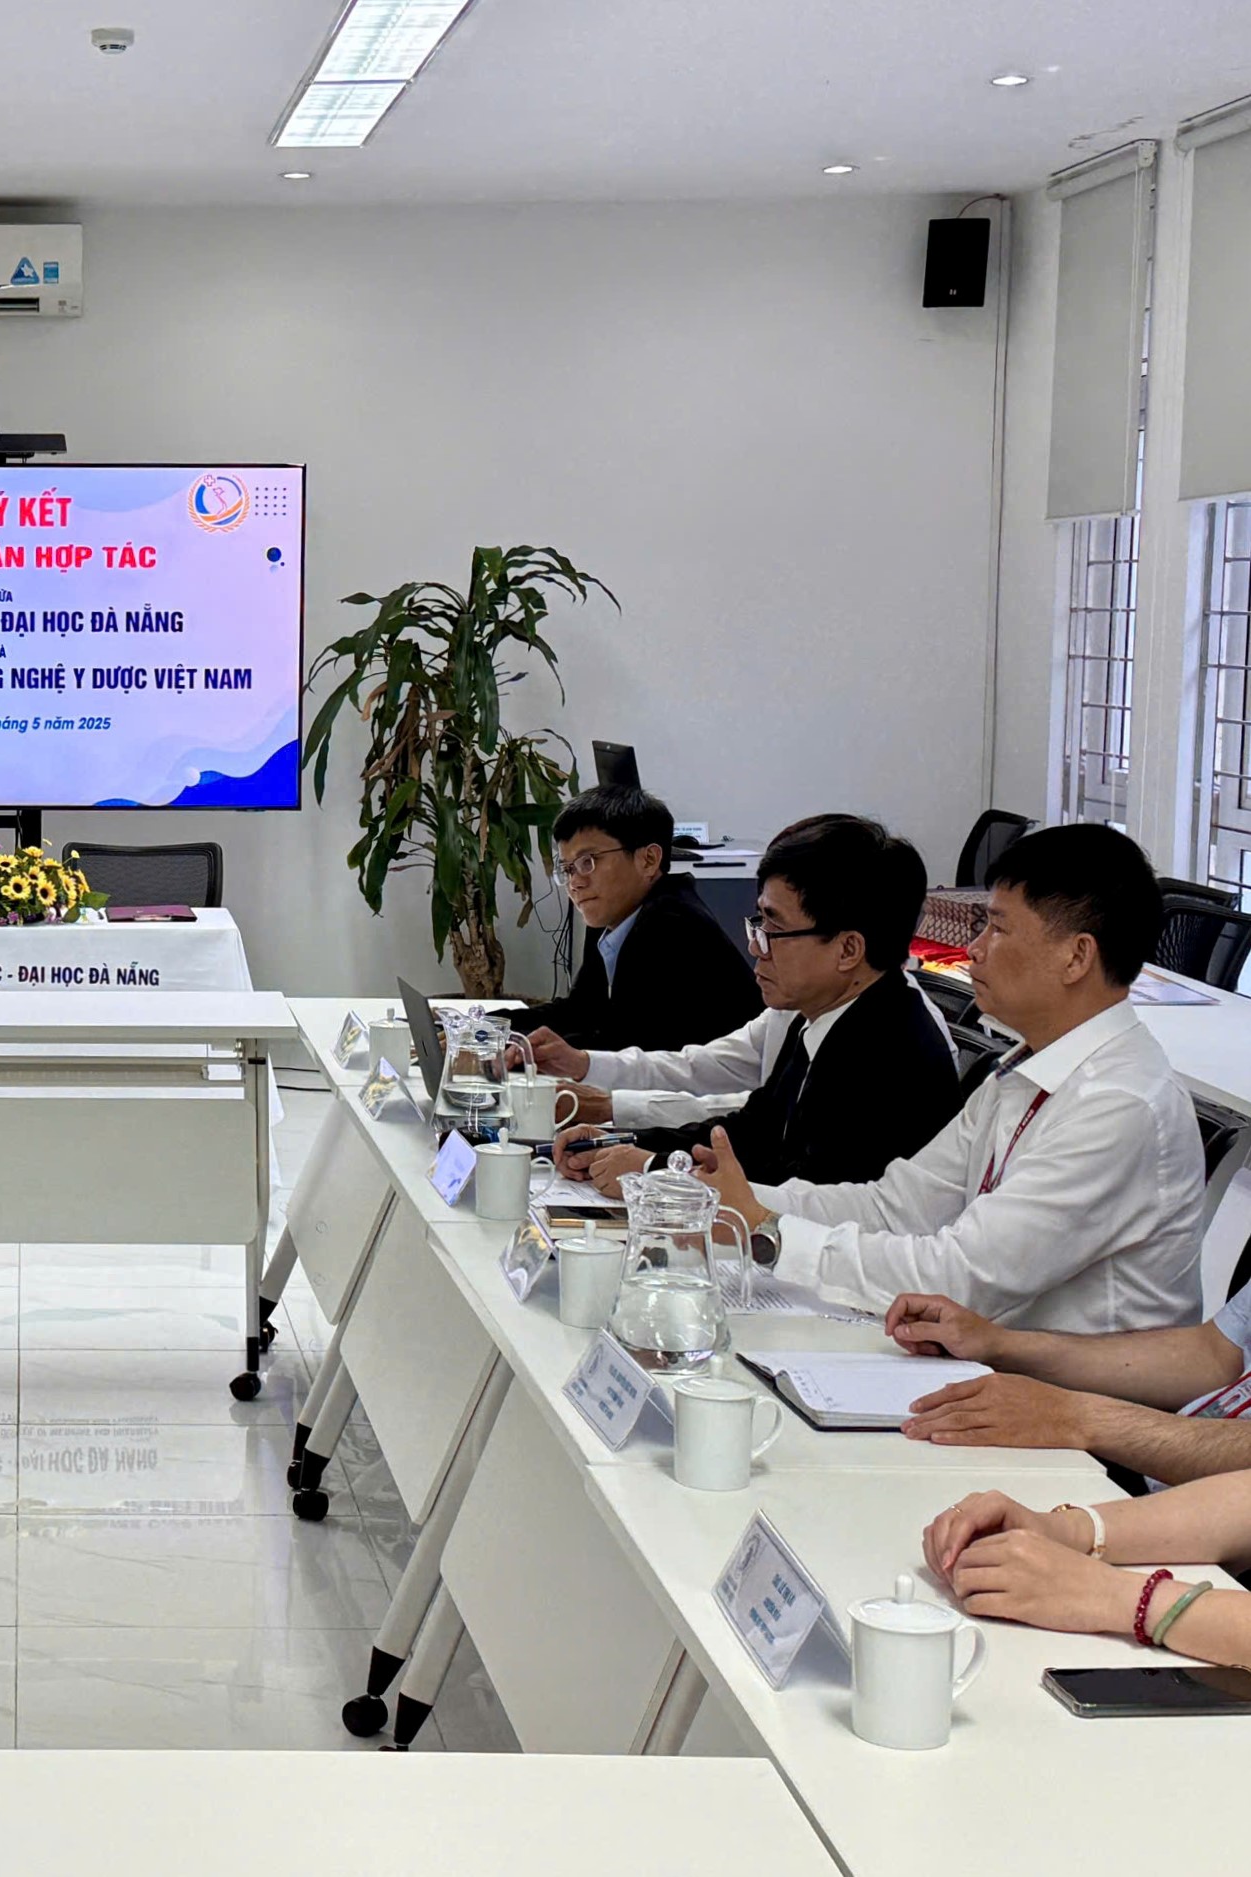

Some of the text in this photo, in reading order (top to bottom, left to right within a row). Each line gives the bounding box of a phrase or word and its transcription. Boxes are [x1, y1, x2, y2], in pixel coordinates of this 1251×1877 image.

[19, 487, 72, 527] KẾT
[35, 543, 92, 573] HỢP
[102, 542, 156, 568] TÁC
[0, 611, 35, 637] ĐẠI
[42, 611, 84, 637] HỌC
[90, 607, 118, 632] ĐÀ
[125, 603, 184, 633] NẴNG
[10, 663, 65, 694] NGHỆ
[73, 668, 85, 689] Y
[92, 666, 147, 694] DƯỢC
[154, 664, 197, 694] VIỆT
[204, 668, 252, 689] NAM
[32, 717, 41, 730] 5
[44, 716, 74, 730] năm
[78, 717, 111, 730] 2025
[18, 966, 45, 987] ĐẠI
[51, 966, 84, 987] HỌC
[89, 963, 110, 985] ĐÀ
[116, 961, 160, 986] NẴNG
